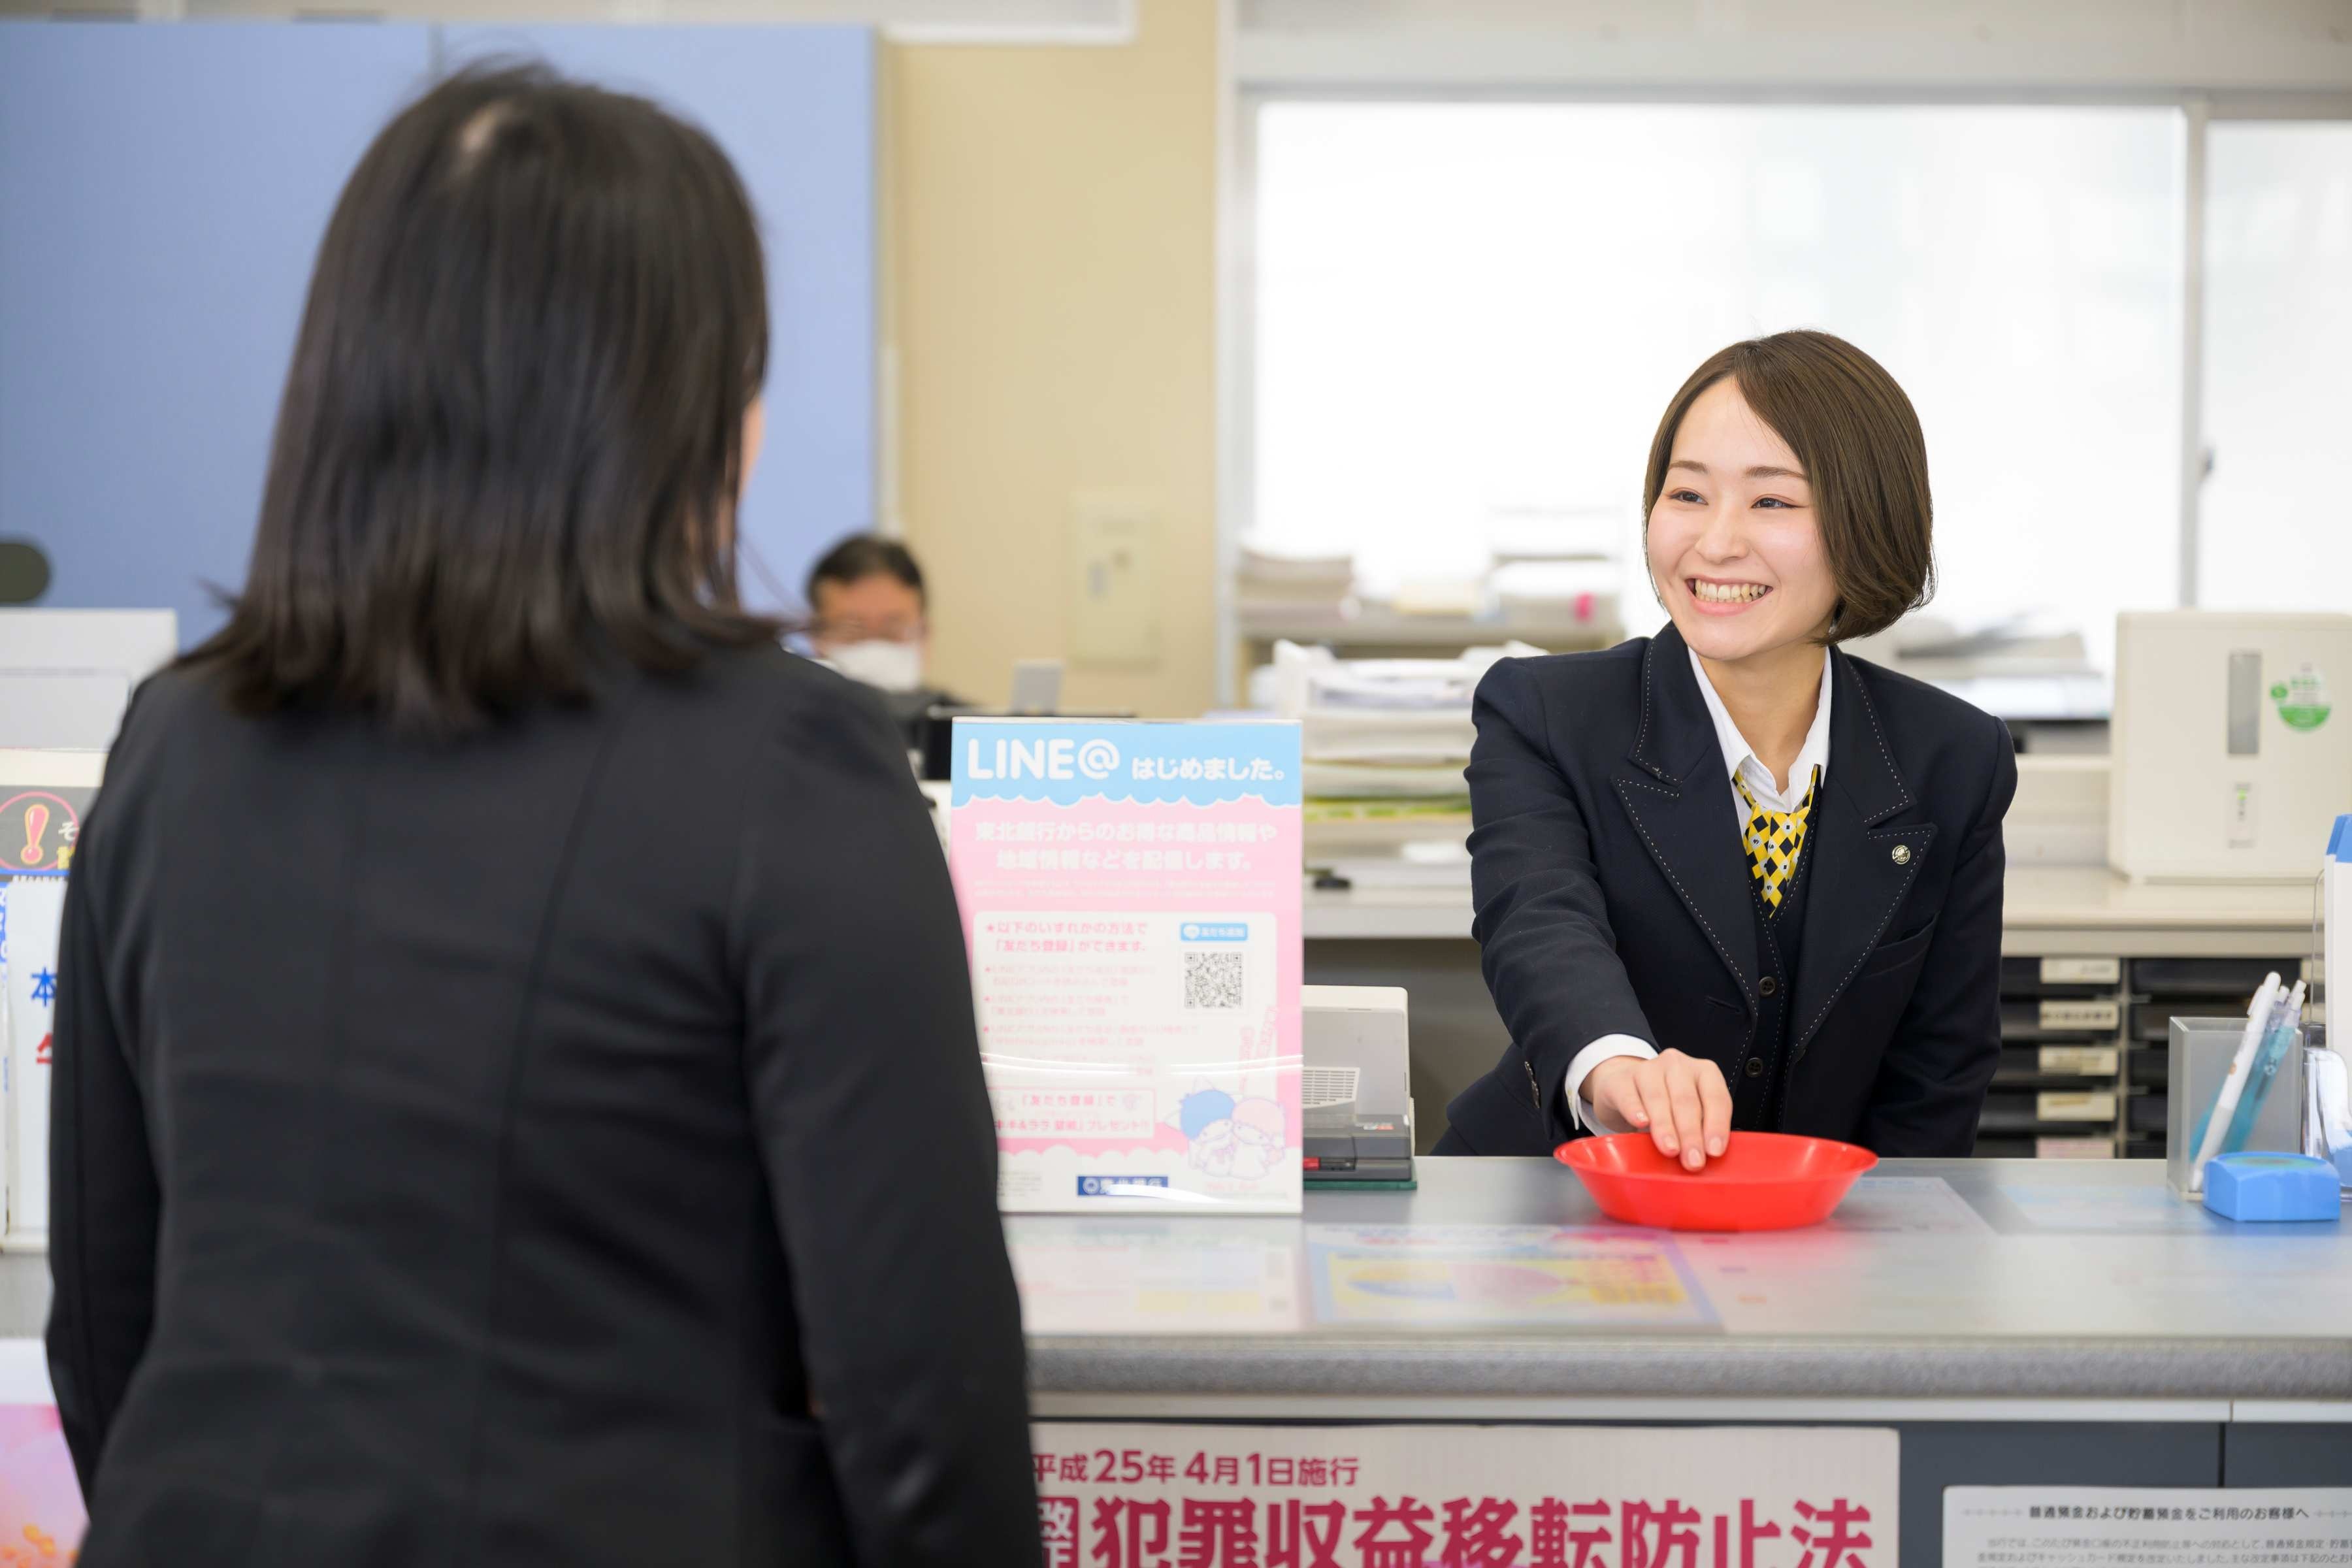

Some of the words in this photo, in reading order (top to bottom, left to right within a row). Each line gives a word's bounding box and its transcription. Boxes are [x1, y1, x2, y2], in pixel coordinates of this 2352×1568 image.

[968, 738, 1120, 780] LINE@
[1132, 757, 1285, 781] はじめました。
[1092, 1495, 1873, 1568] 犯罪収益移転防止法
